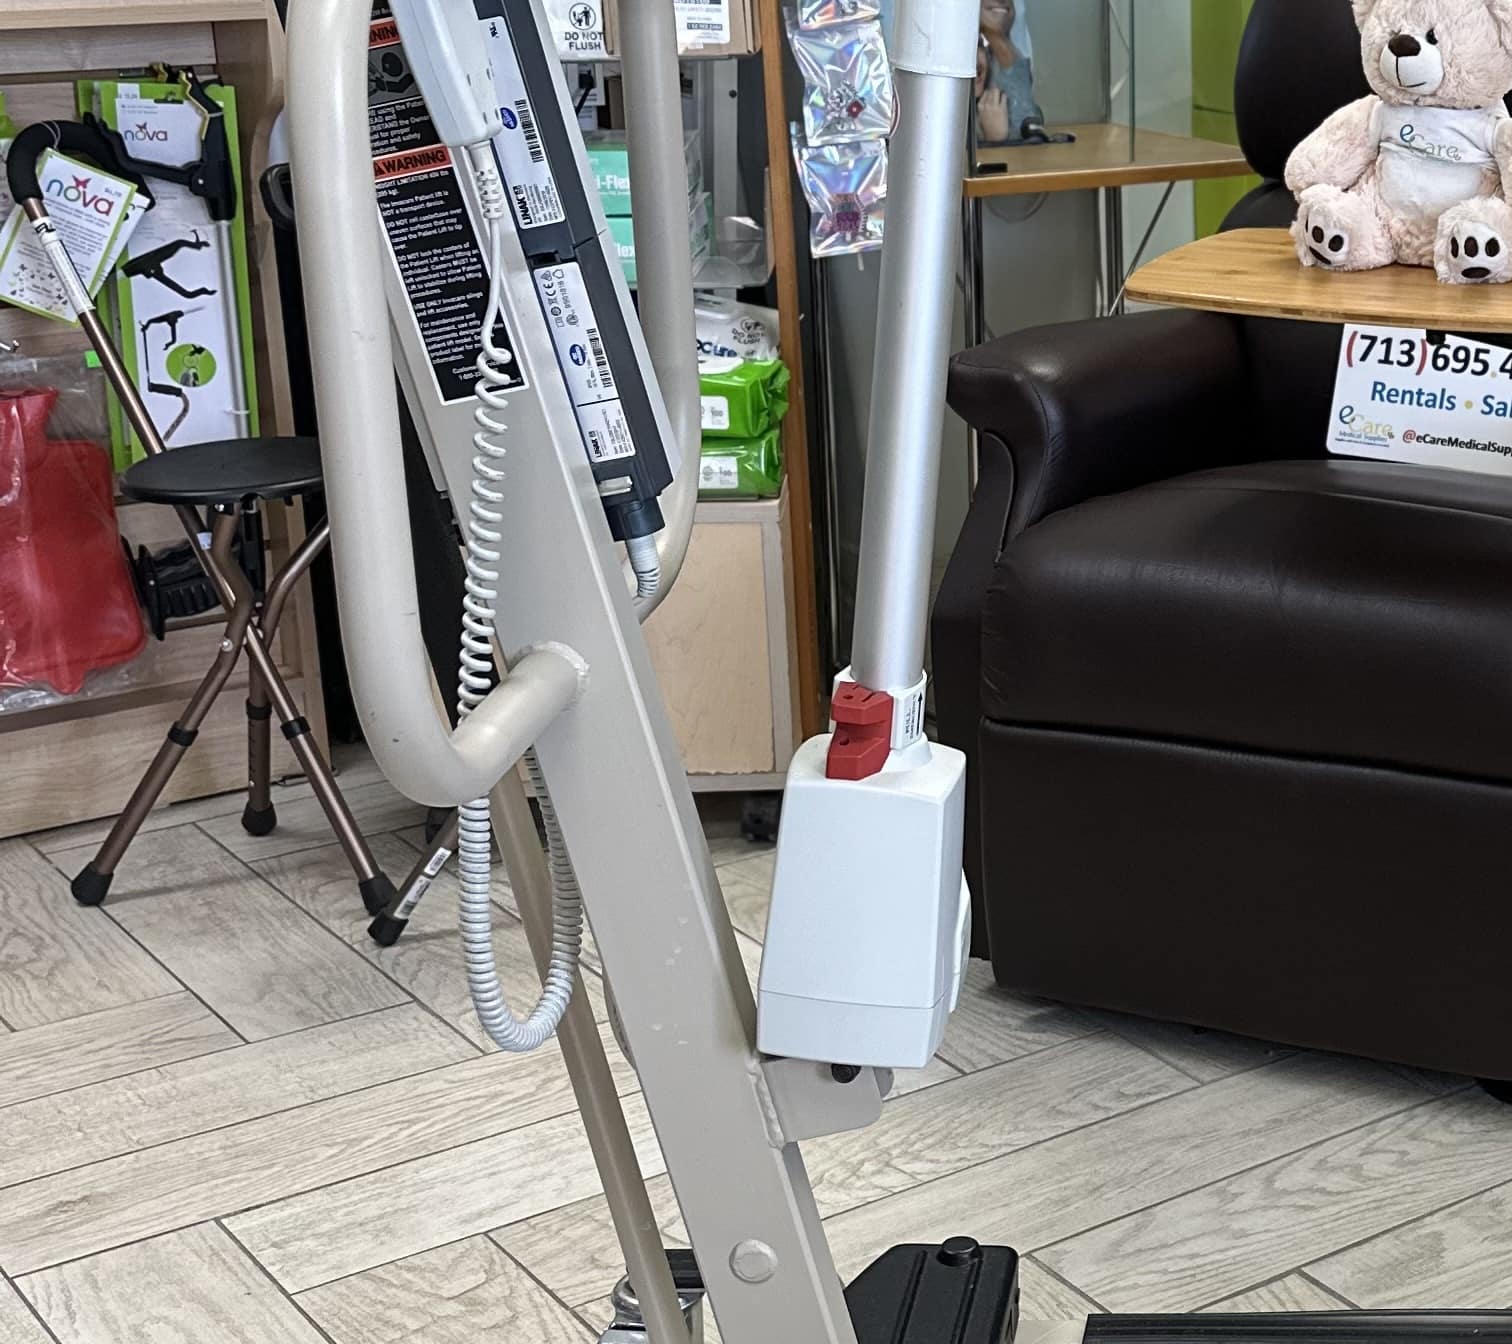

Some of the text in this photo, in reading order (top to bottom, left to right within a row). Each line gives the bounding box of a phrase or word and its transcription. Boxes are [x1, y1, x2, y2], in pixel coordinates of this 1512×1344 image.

[564, 31, 604, 41] DO NOT
[569, 41, 602, 51] FLUSH
[124, 129, 168, 142] nova
[1400, 123, 1458, 159] eCare
[382, 149, 447, 173] WARNING
[46, 179, 115, 217] nova
[1371, 381, 1457, 411] Rentals
[1339, 405, 1393, 436] eCare
[1339, 430, 1362, 439] Medical
[1364, 434, 1387, 443] Supplies
